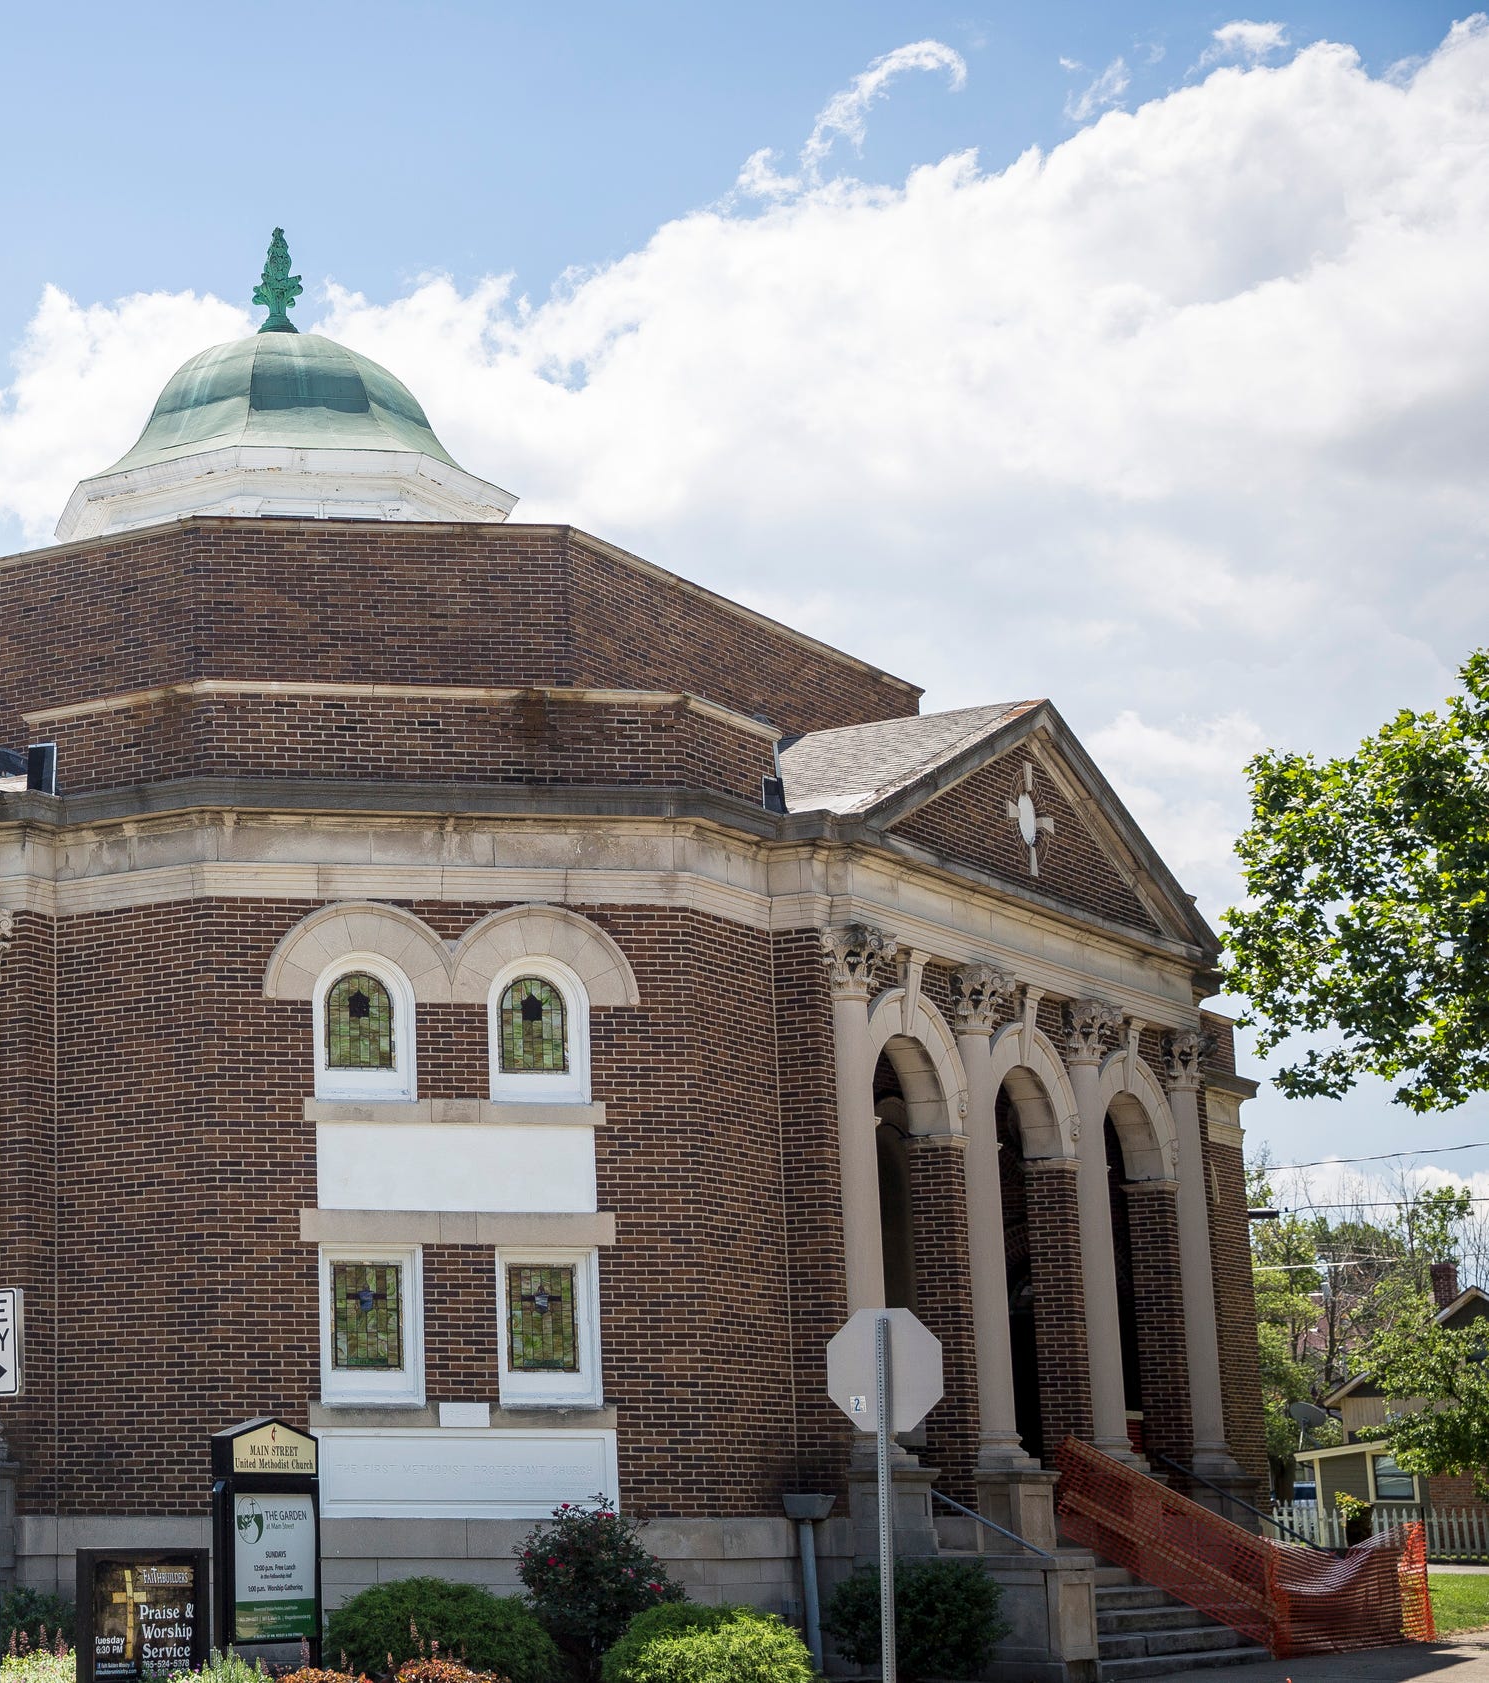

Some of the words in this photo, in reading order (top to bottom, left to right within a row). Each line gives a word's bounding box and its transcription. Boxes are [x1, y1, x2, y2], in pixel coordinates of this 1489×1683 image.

[854, 1398, 861, 1412] 2
[250, 1445, 269, 1456] MAIN
[272, 1446, 298, 1457] STREET
[235, 1458, 256, 1469] United
[259, 1458, 289, 1469] Methodist
[292, 1459, 314, 1470] Church
[333, 1464, 358, 1475] THE
[363, 1464, 398, 1475] FIRST
[401, 1464, 469, 1476] METHODIST
[550, 1464, 593, 1476] CHURCH
[264, 1510, 278, 1521] THE
[279, 1510, 307, 1521] GARDEN
[265, 1550, 287, 1558] SUNDAYS
[142, 1566, 188, 1584] FAITHBUILDERS
[139, 1604, 180, 1620] Praise
[185, 1603, 194, 1618] &
[141, 1622, 193, 1640] Worship
[95, 1636, 125, 1645] Tuesday
[96, 1645, 110, 1654] 6:30
[112, 1645, 123, 1654] PM
[142, 1643, 191, 1659] Service
